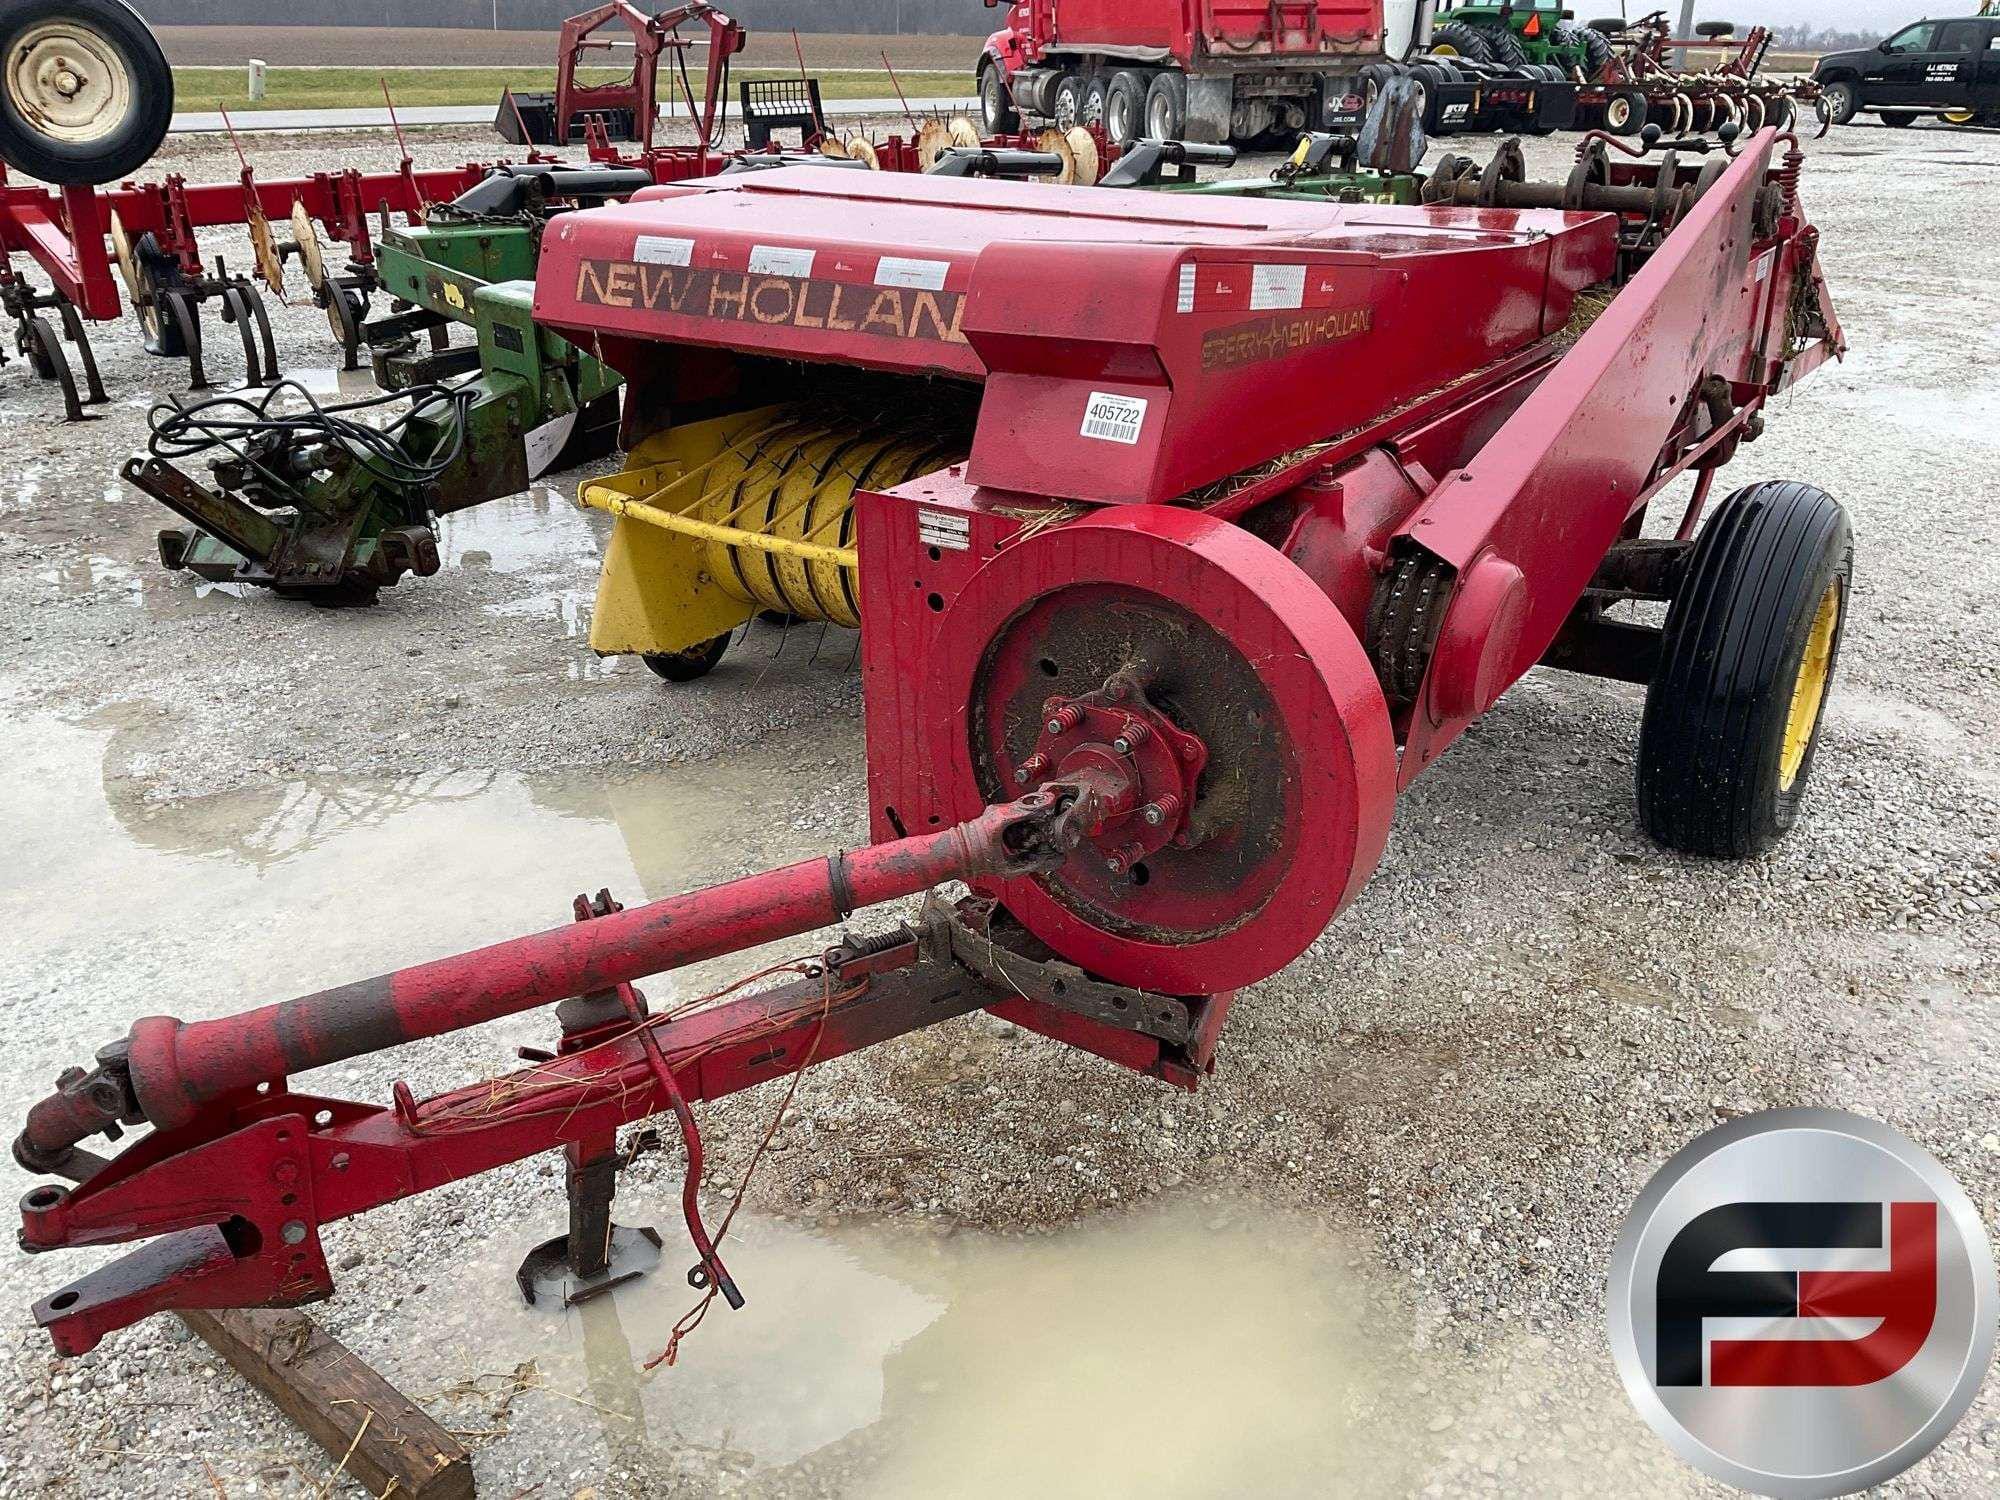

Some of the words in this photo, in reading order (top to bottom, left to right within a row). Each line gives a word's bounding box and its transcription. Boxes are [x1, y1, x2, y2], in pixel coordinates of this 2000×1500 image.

[576, 259, 695, 311] NEW
[707, 271, 969, 345] HOLLAN
[1281, 318, 1314, 347] NEW
[1090, 403, 1139, 425] 405722
